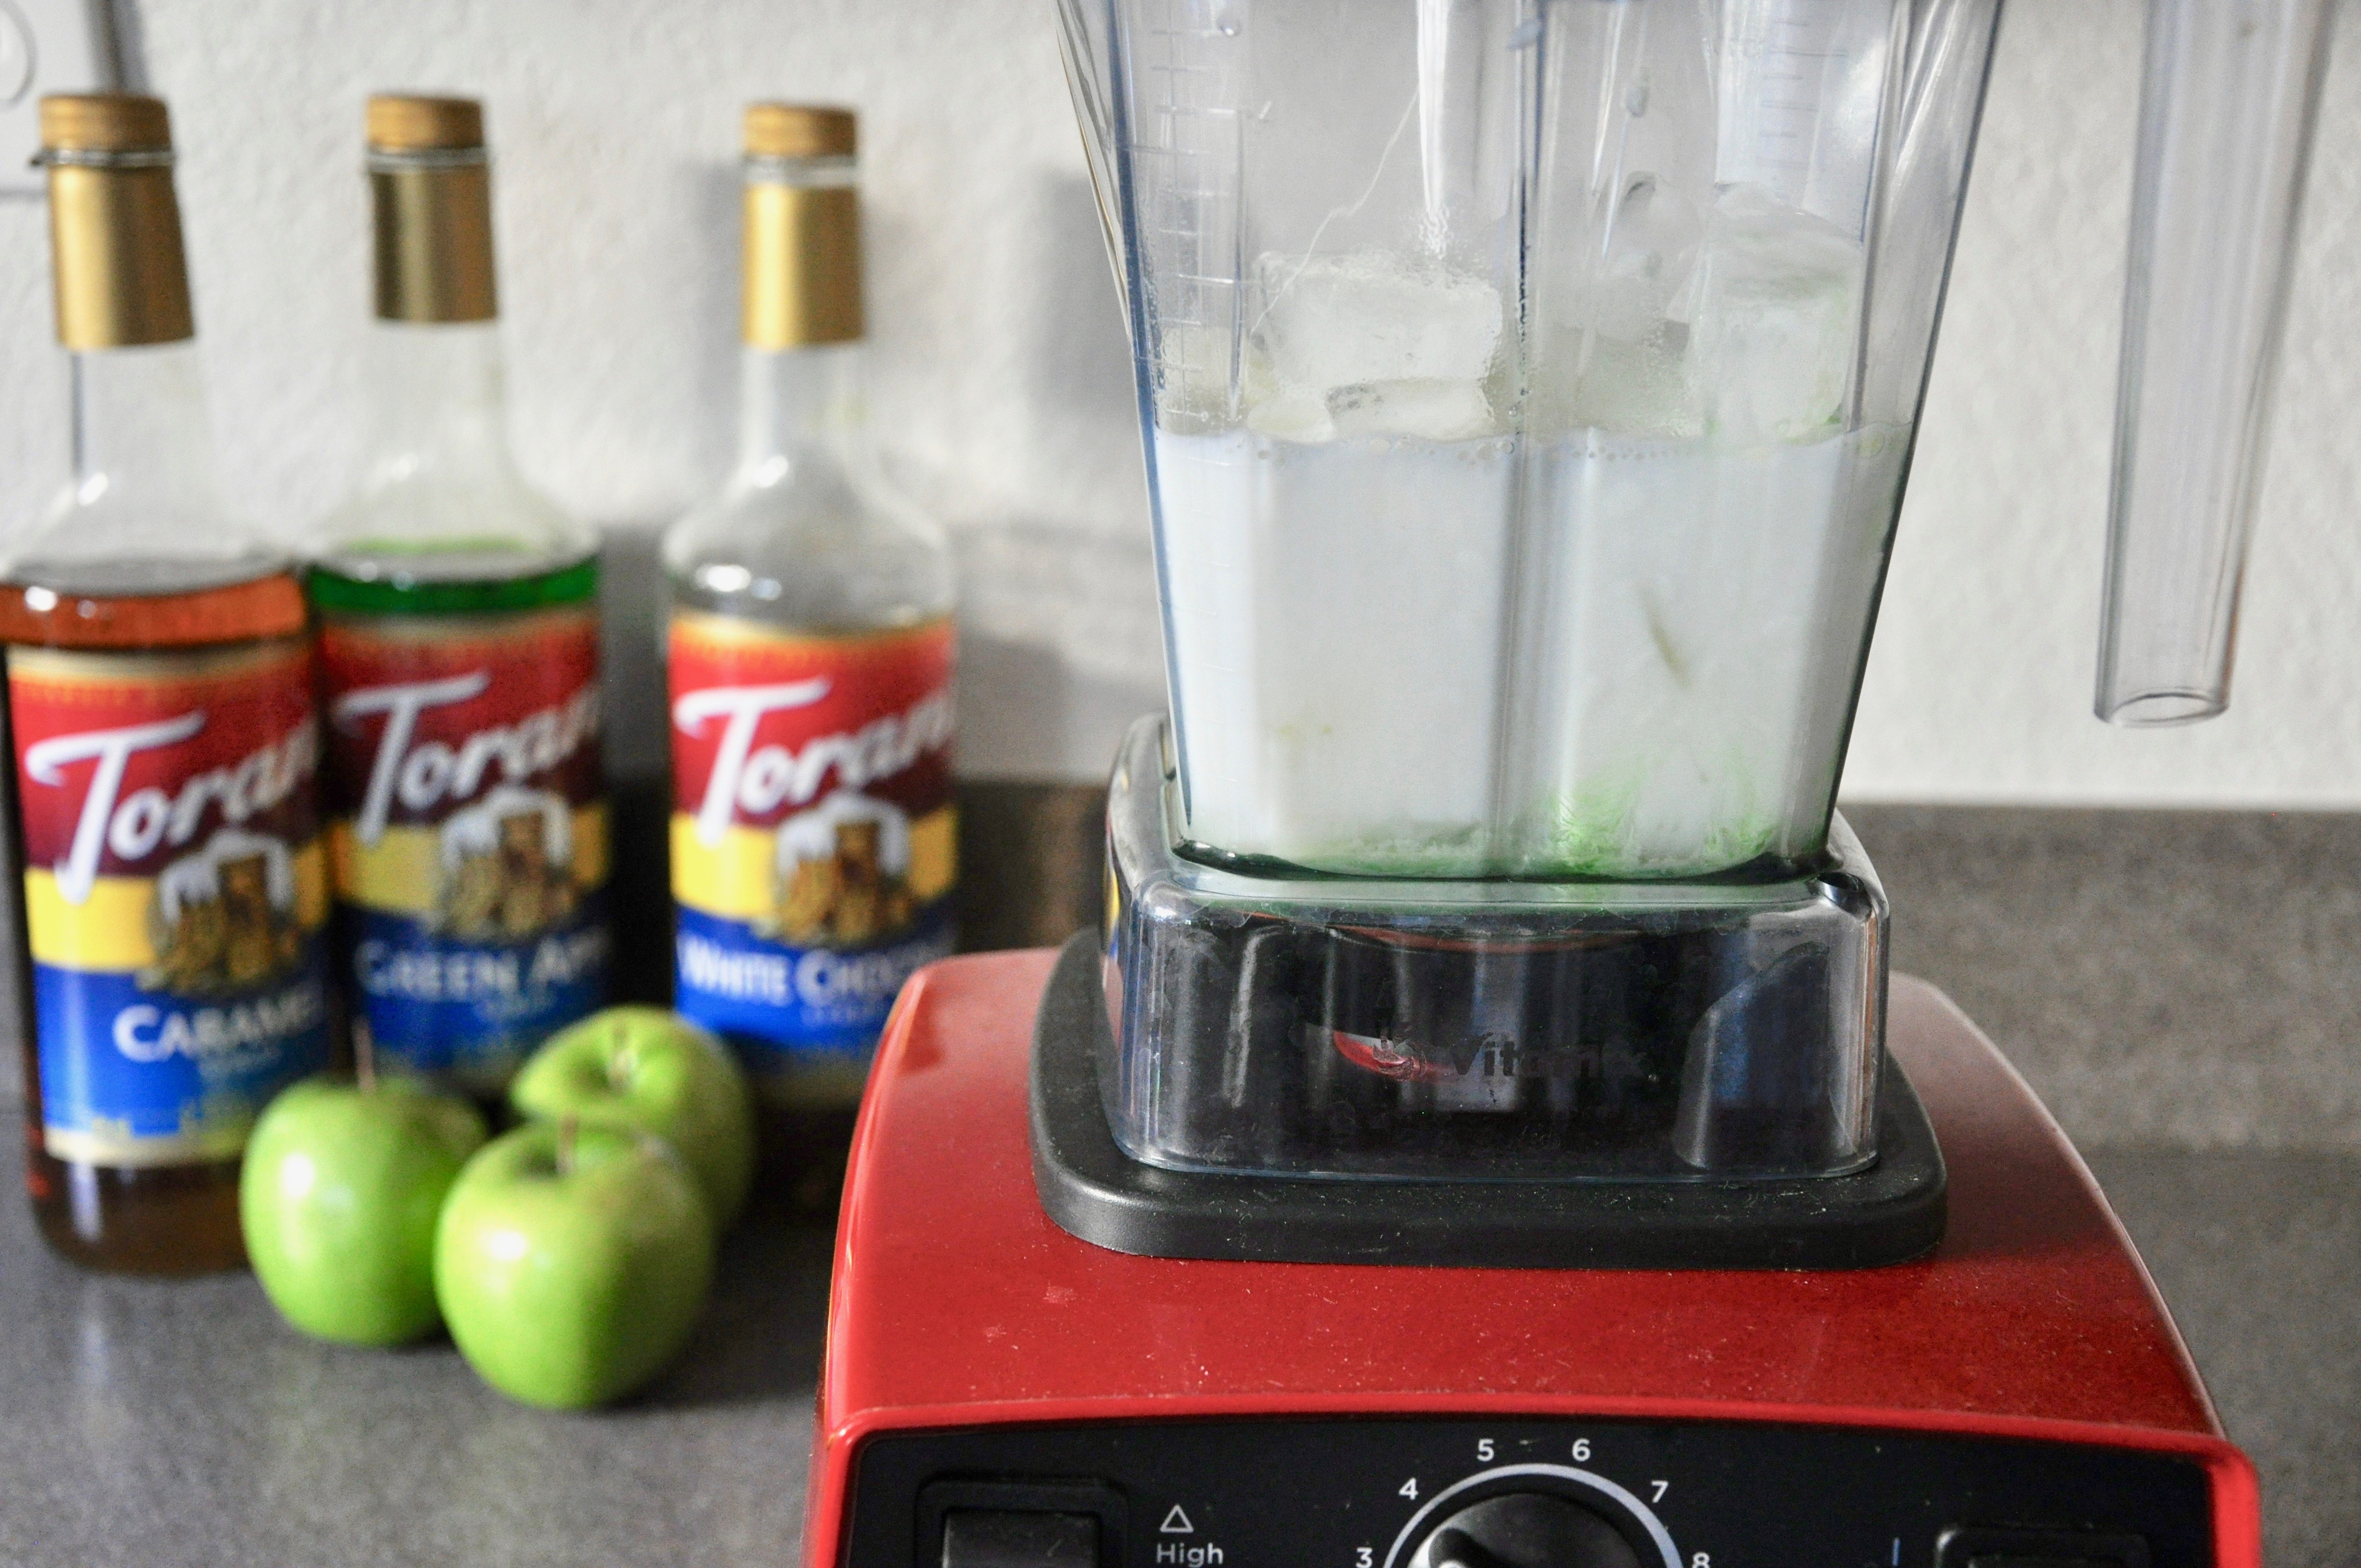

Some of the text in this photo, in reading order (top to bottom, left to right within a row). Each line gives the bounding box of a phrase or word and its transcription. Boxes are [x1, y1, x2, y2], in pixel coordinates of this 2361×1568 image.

[353, 938, 520, 999] GREEN
[676, 934, 791, 1006] WHITE
[1477, 1439, 1494, 1461] 5
[1572, 1439, 1591, 1461] 6
[1399, 1478, 1418, 1500] 4
[1651, 1482, 1668, 1503] 7
[1157, 1543, 1223, 1568] High
[1356, 1547, 1373, 1568] 3
[1692, 1551, 1710, 1568] 8
